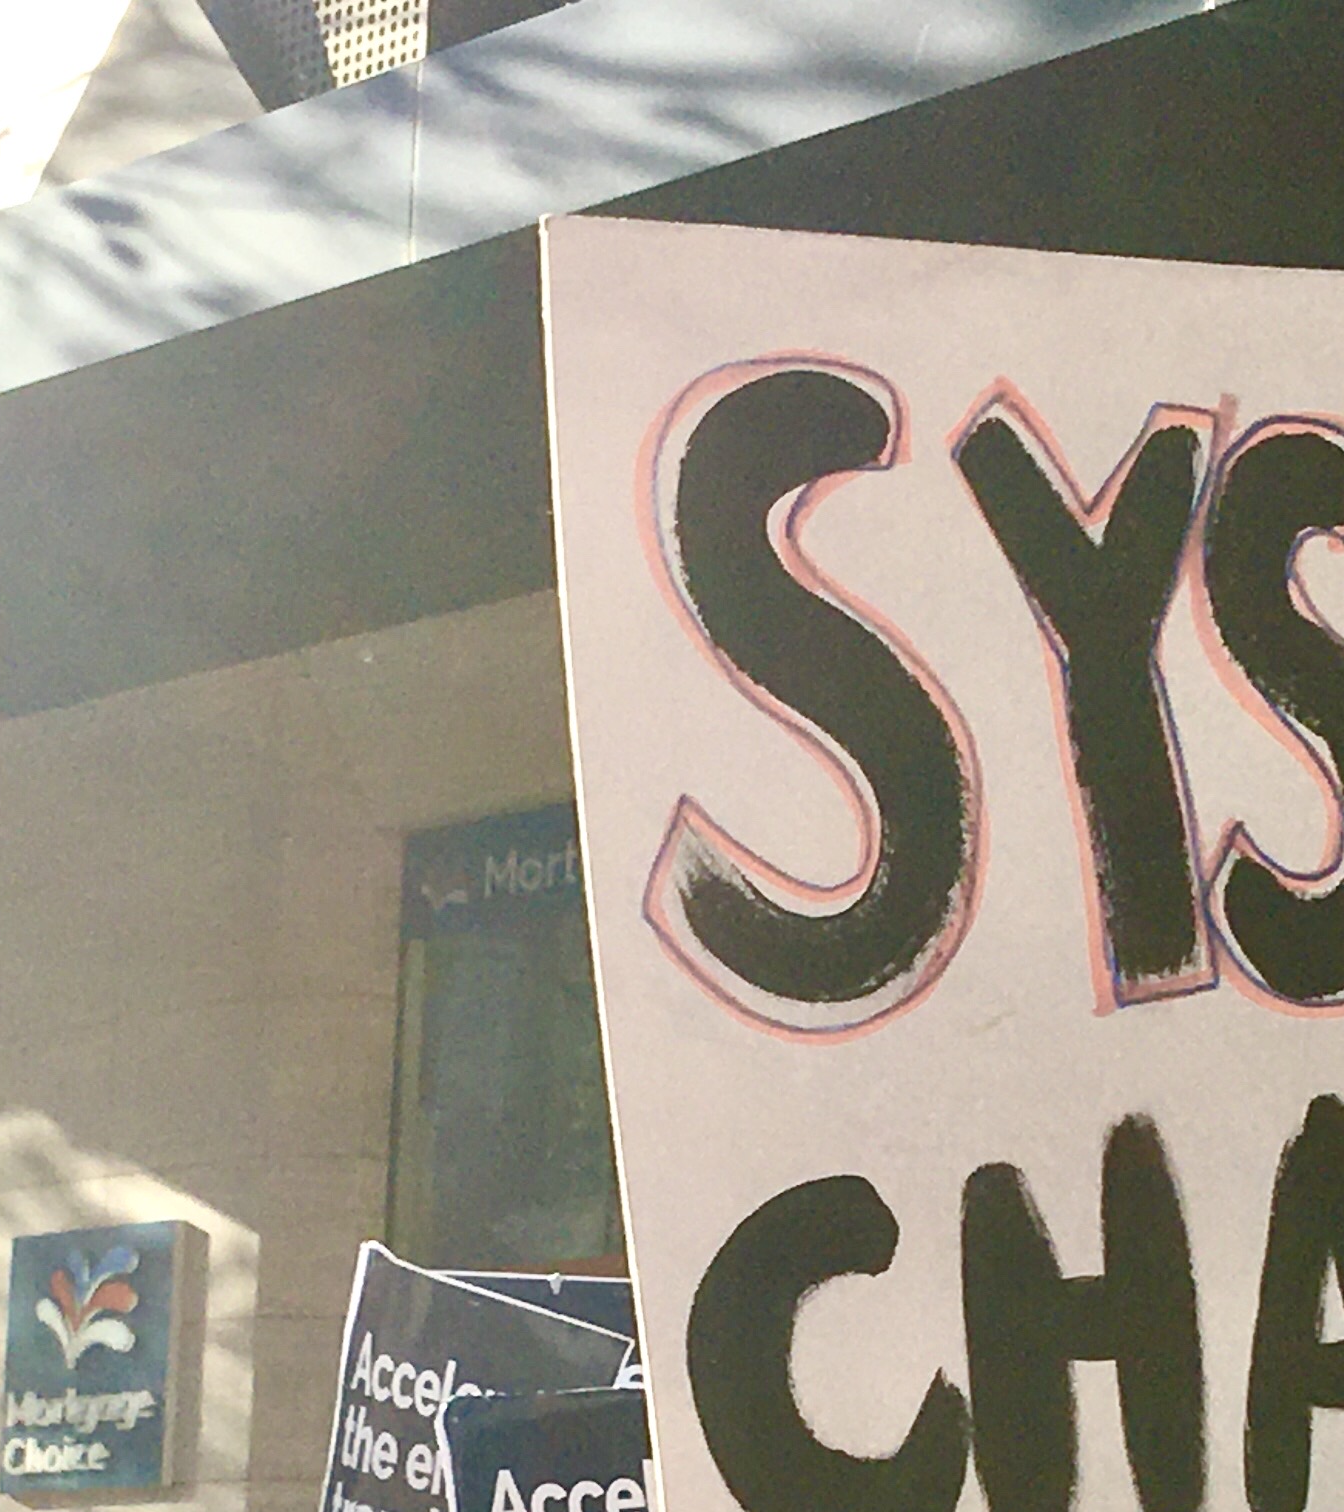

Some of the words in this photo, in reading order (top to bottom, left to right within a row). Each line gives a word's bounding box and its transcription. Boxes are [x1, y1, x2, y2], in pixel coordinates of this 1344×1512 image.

[6, 1387, 156, 1434] Mortgage
[3, 1436, 112, 1476] Choice
[340, 1405, 398, 1480] the
